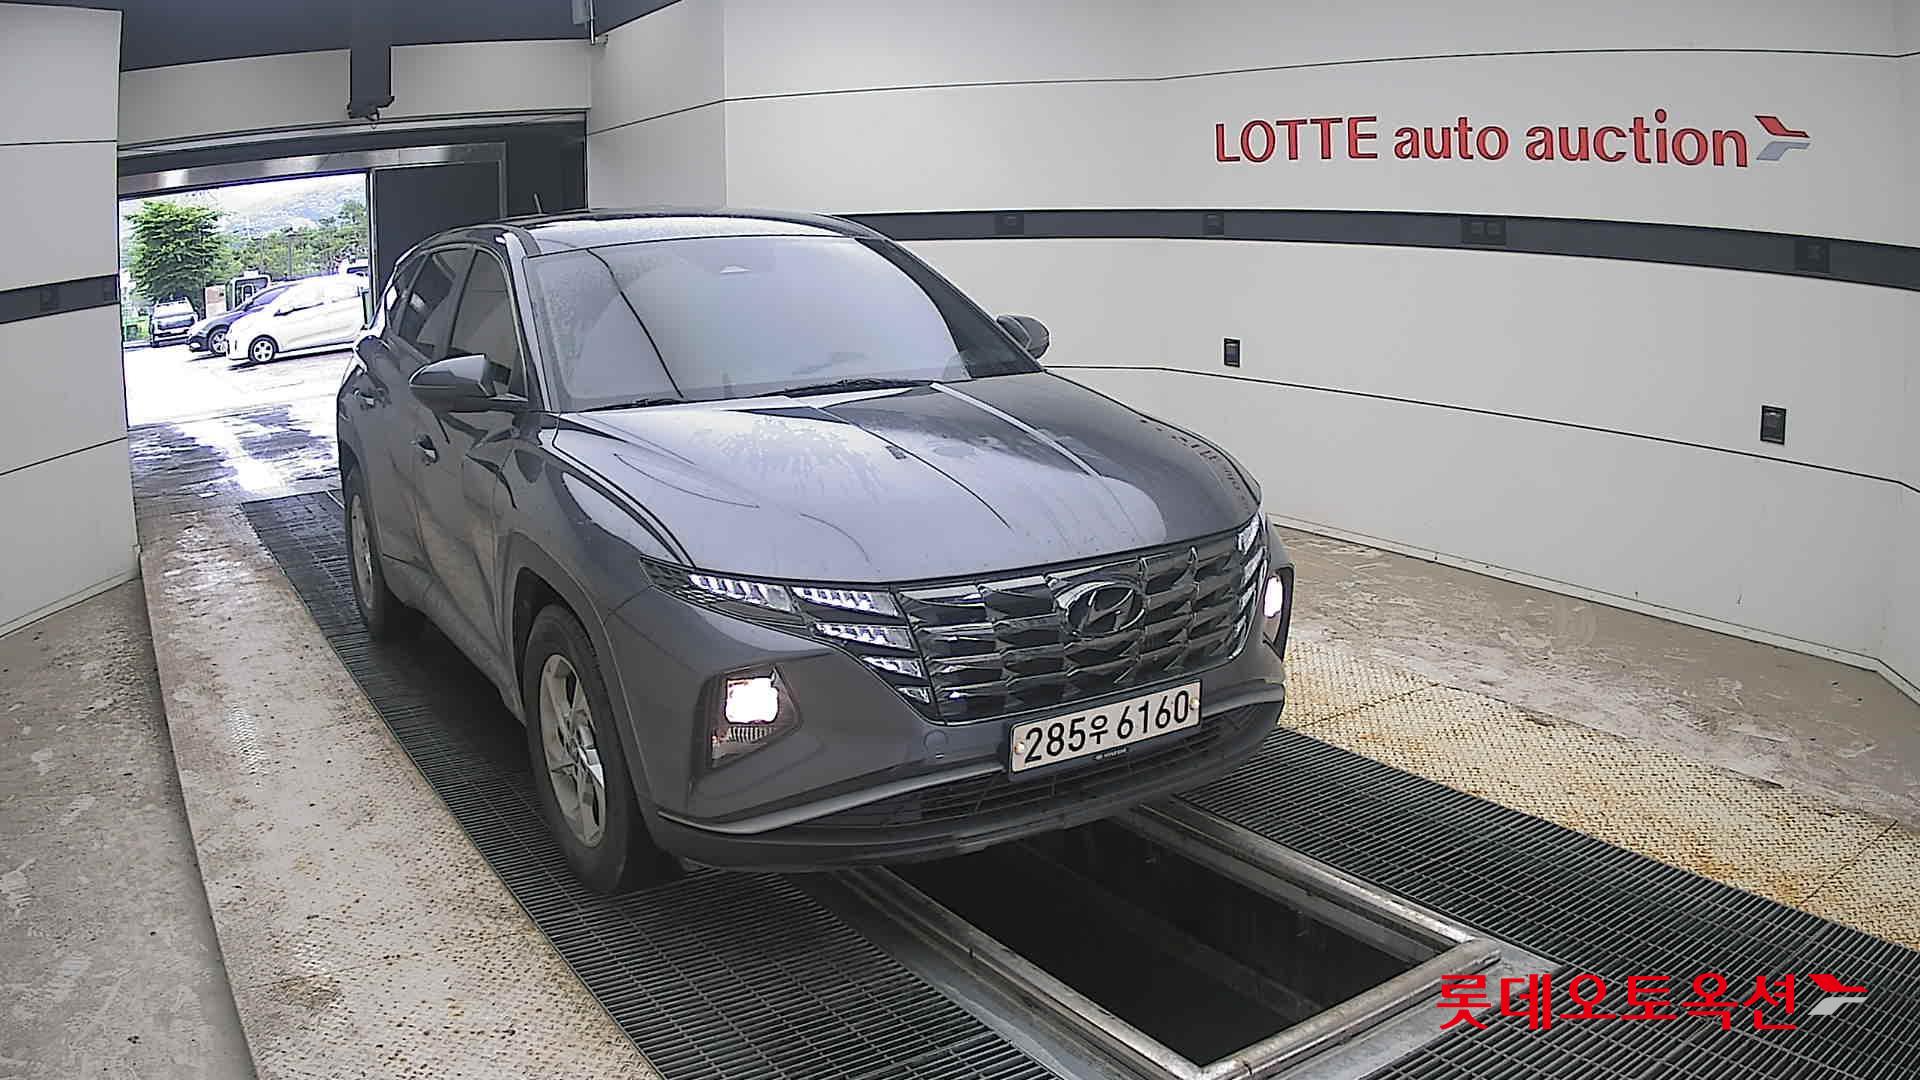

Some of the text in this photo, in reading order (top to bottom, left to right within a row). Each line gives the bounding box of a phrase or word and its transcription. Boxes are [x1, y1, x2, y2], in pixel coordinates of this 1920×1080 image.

[1215, 108, 1749, 168] LOTTE auto auction
[1117, 690, 1190, 740] 6160
